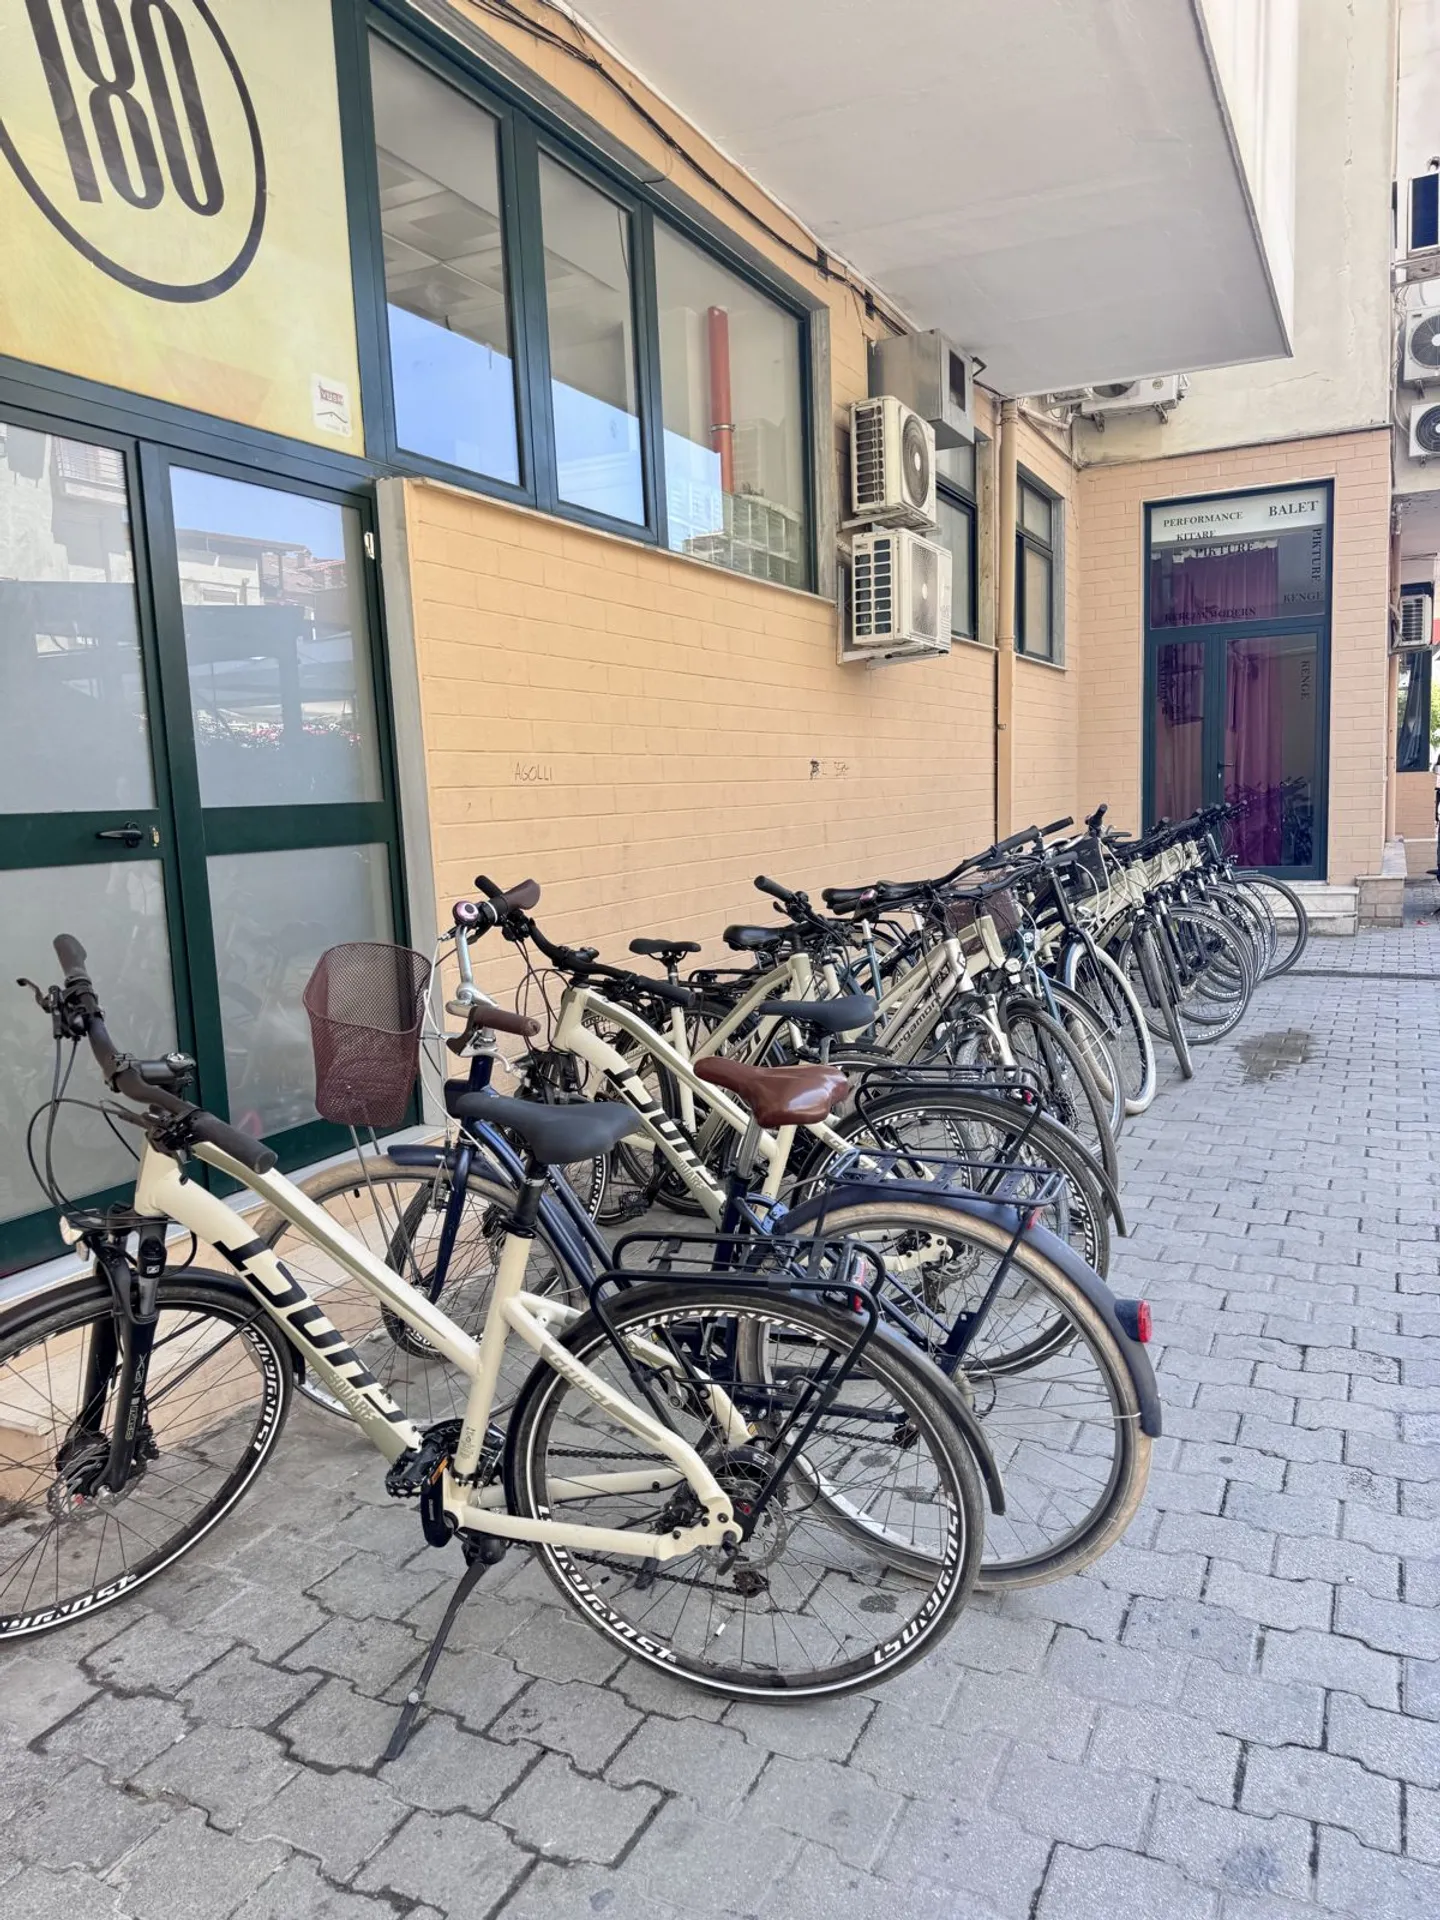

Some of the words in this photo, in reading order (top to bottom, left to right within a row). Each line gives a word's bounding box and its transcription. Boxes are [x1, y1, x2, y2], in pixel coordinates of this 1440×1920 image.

[26, 0, 225, 217] 180
[1268, 500, 1319, 517] BALET
[1163, 511, 1244, 528] PERFORMANCE
[1176, 529, 1217, 542] KITARE
[513, 761, 553, 782] AGOLLI
[549, 1352, 613, 1406] GHOST
[328, 1373, 377, 1422] SQUARE
